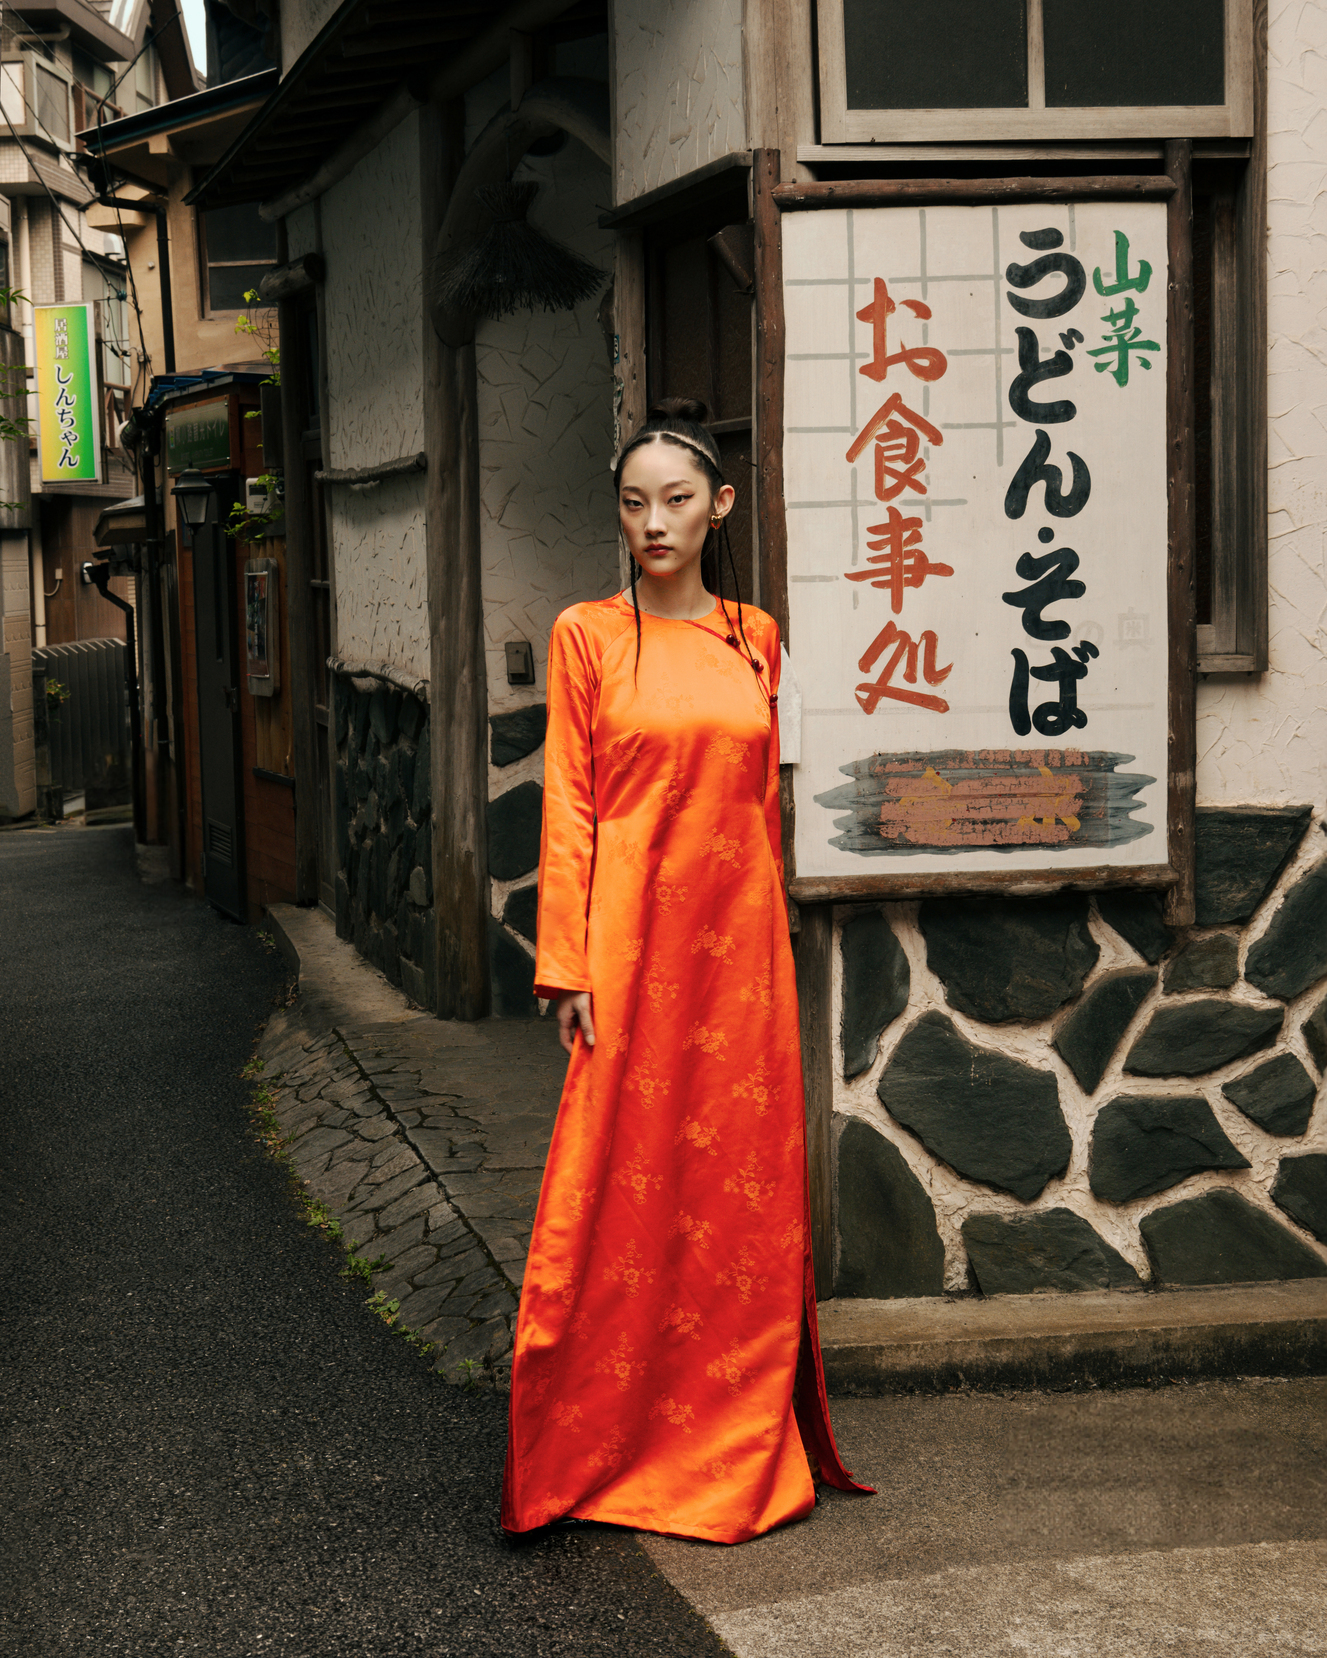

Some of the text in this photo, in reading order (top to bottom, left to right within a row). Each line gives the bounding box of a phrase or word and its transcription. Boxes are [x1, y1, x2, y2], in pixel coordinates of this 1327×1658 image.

[54, 318, 69, 360] 居酒屋
[1086, 229, 1161, 388] 山菜
[54, 364, 80, 469] しんちゃん
[844, 277, 955, 715] お食事処
[1002, 227, 1099, 737] うどん・そば
